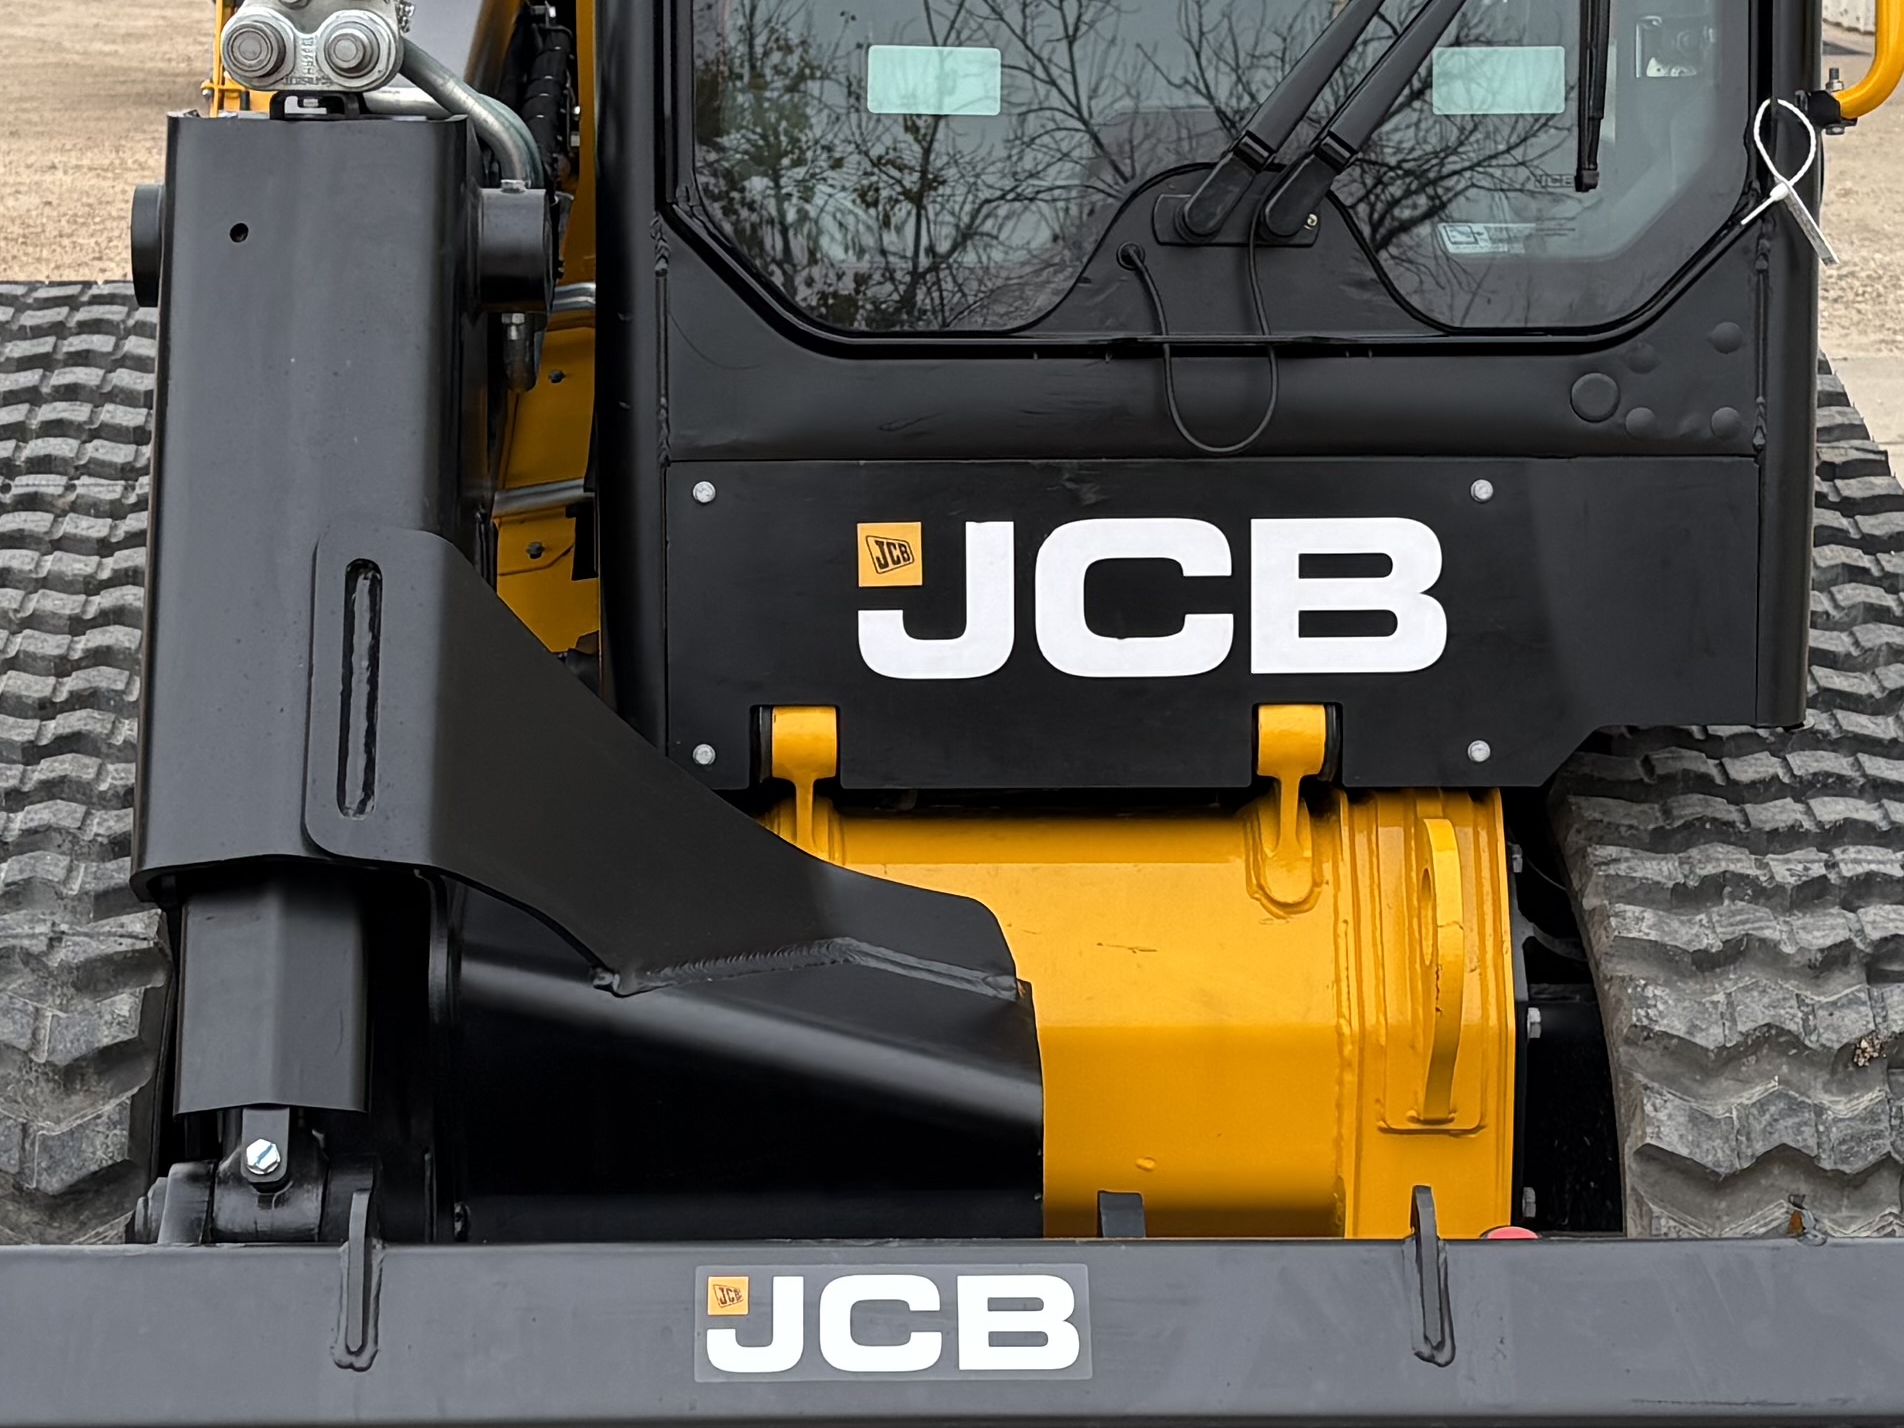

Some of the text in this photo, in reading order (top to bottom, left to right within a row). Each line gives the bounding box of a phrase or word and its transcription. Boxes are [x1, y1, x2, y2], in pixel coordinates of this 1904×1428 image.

[857, 517, 1448, 680] JCB
[874, 539, 911, 570] JCB
[706, 1274, 1080, 1373] JCB
